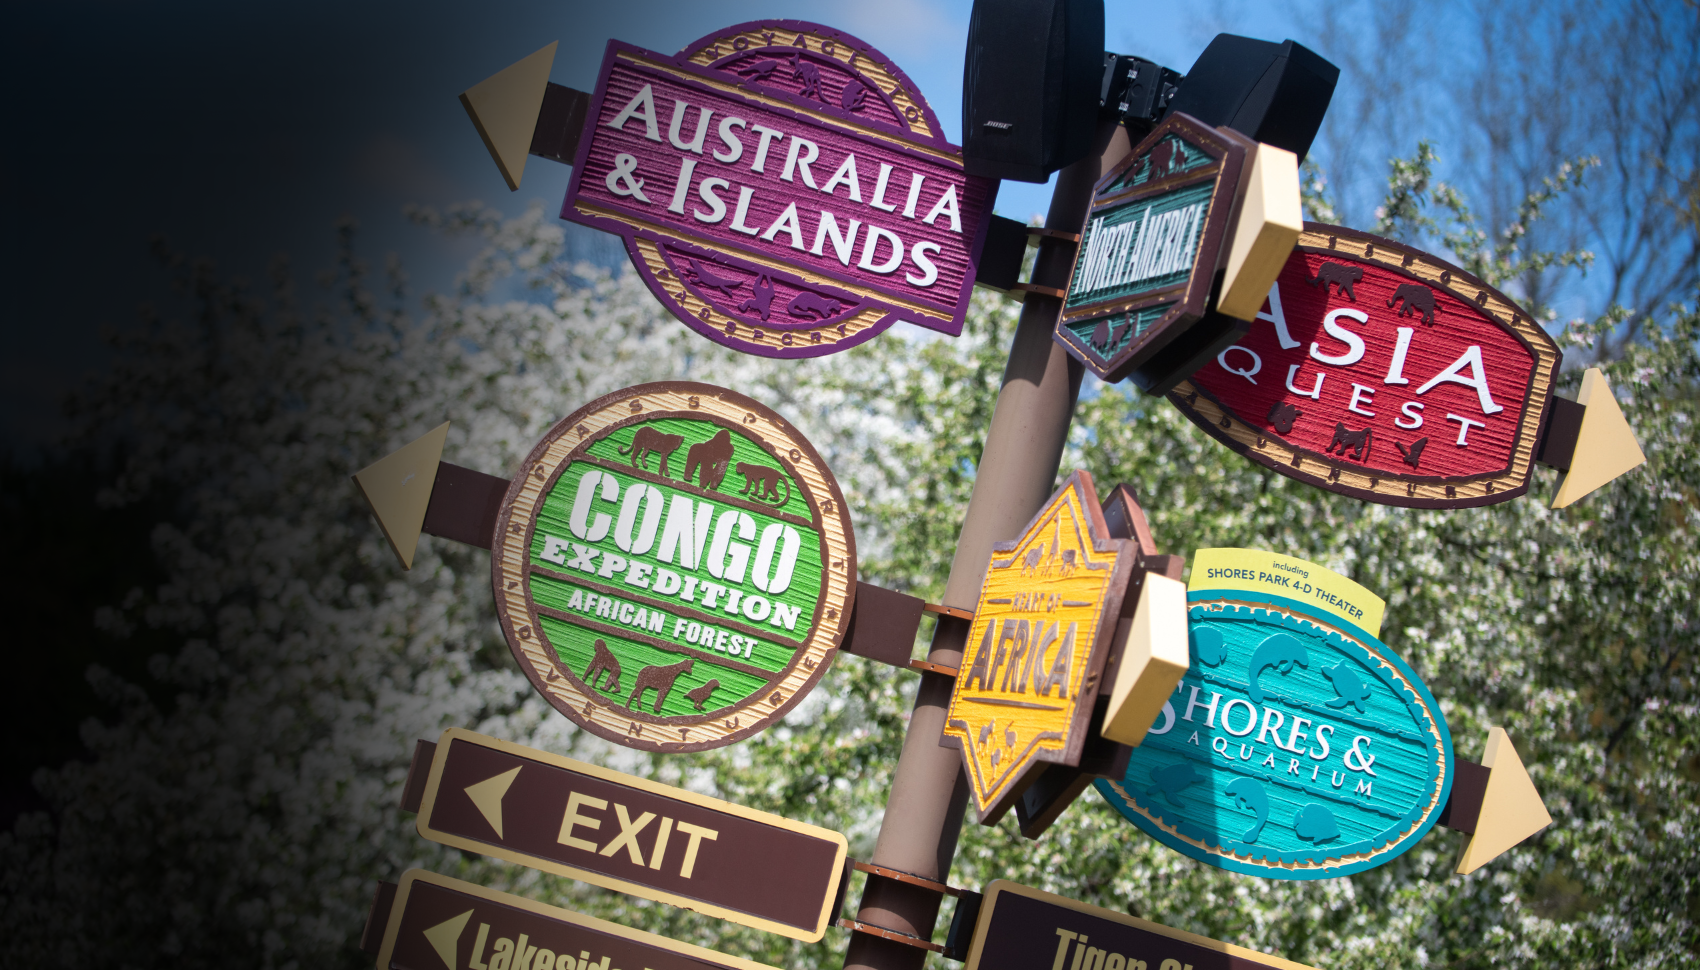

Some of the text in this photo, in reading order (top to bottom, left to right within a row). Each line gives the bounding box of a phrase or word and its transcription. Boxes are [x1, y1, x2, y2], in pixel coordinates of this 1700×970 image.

[607, 83, 963, 233] AUSTRALIA
[984, 120, 1012, 130] BOSE
[605, 153, 941, 286] & ISLANDS
[1074, 203, 1203, 294] NORTH AMERICA
[1256, 280, 1503, 414] ASIA
[1217, 345, 1486, 446] QUEST
[533, 395, 845, 572] PASSPORT
[569, 470, 801, 595] CONGO
[1272, 561, 1309, 579] including
[540, 535, 801, 631] EXPEDITION
[567, 589, 758, 659] AFRICAN FOREST
[1012, 592, 1062, 614] HEART OF
[1207, 568, 1364, 620] SHORES PARK 4-D THEATER
[506, 581, 816, 740] ADVENTURE
[964, 618, 1078, 699] AFRICA
[1187, 730, 1373, 797] AQUARIUM
[1343, 735, 1377, 778] &
[557, 790, 719, 879] EXIT
